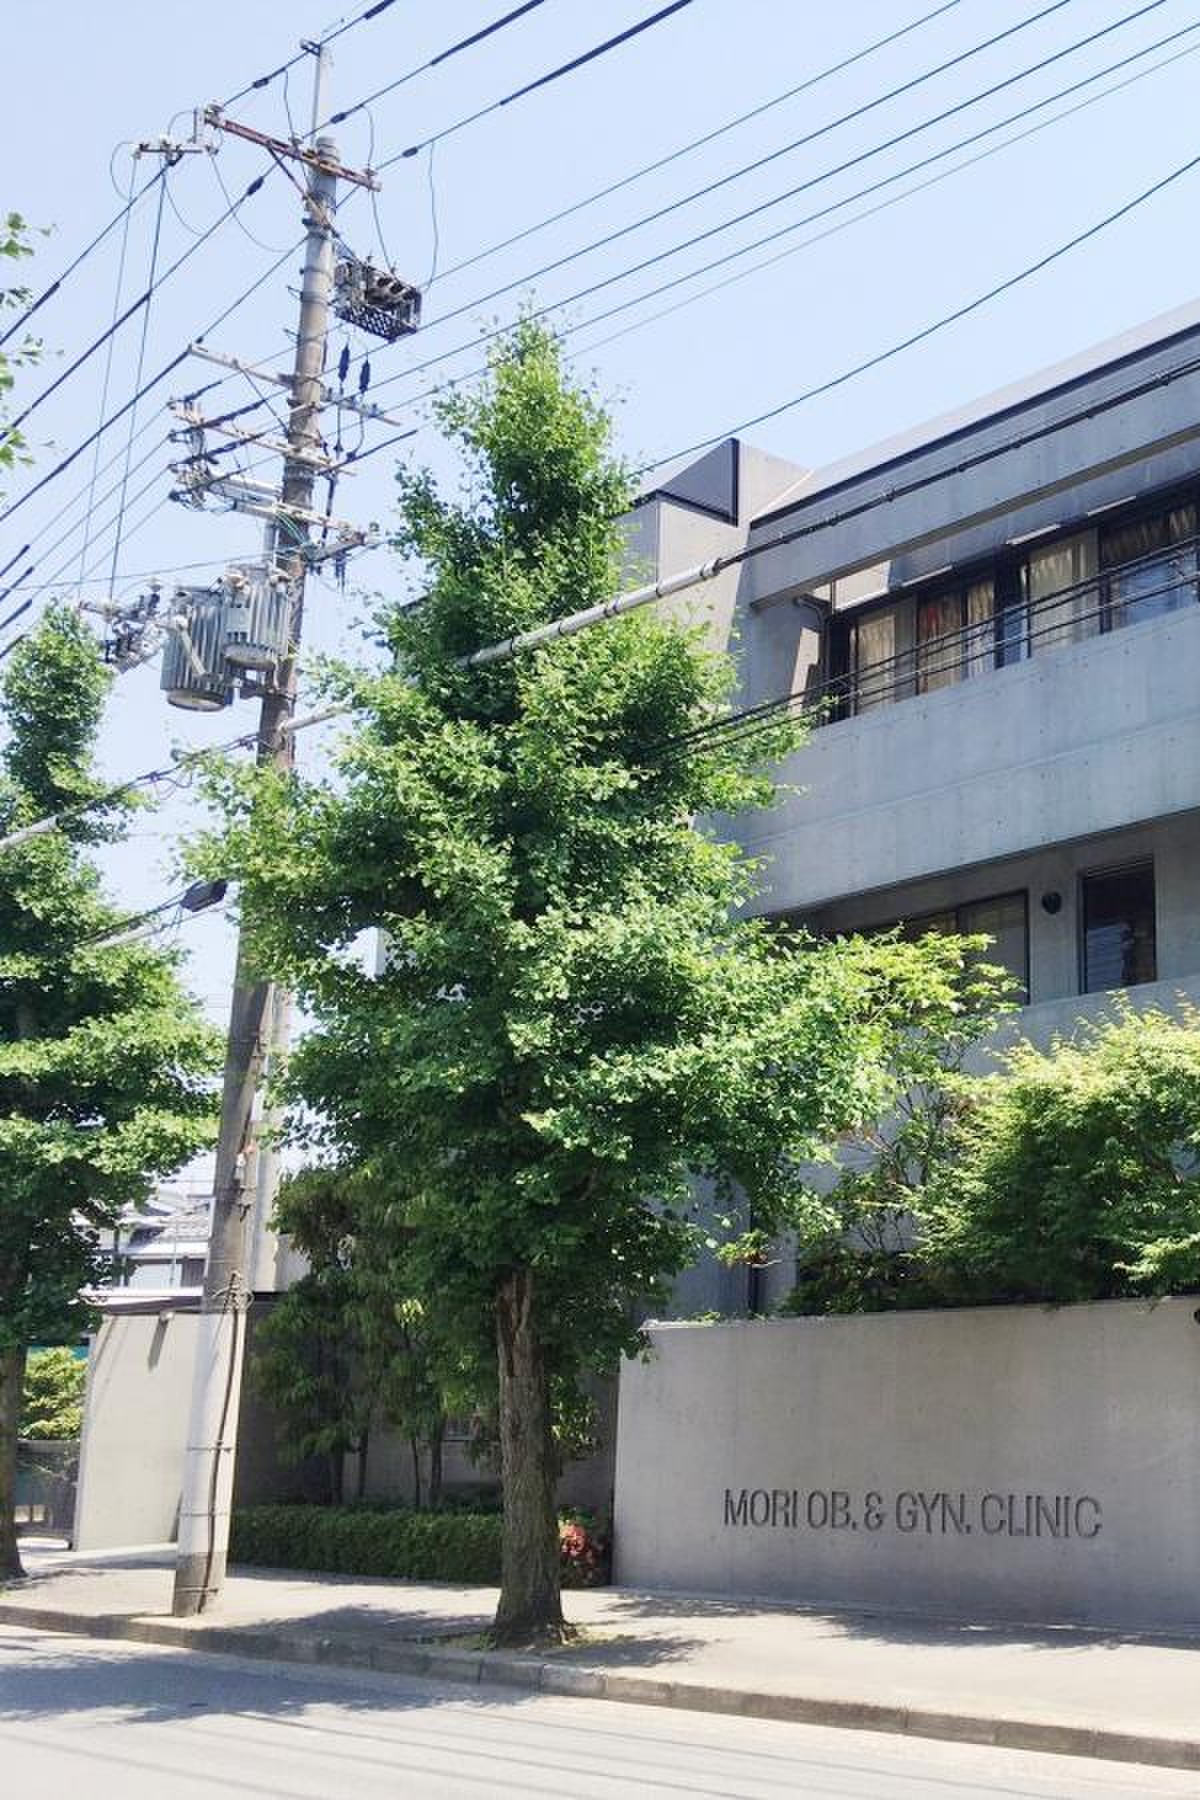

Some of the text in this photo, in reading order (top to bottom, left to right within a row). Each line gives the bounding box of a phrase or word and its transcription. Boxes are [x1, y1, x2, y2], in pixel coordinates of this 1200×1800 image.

[723, 1488, 1103, 1538] MORI OB. & GYN. CLINIC
